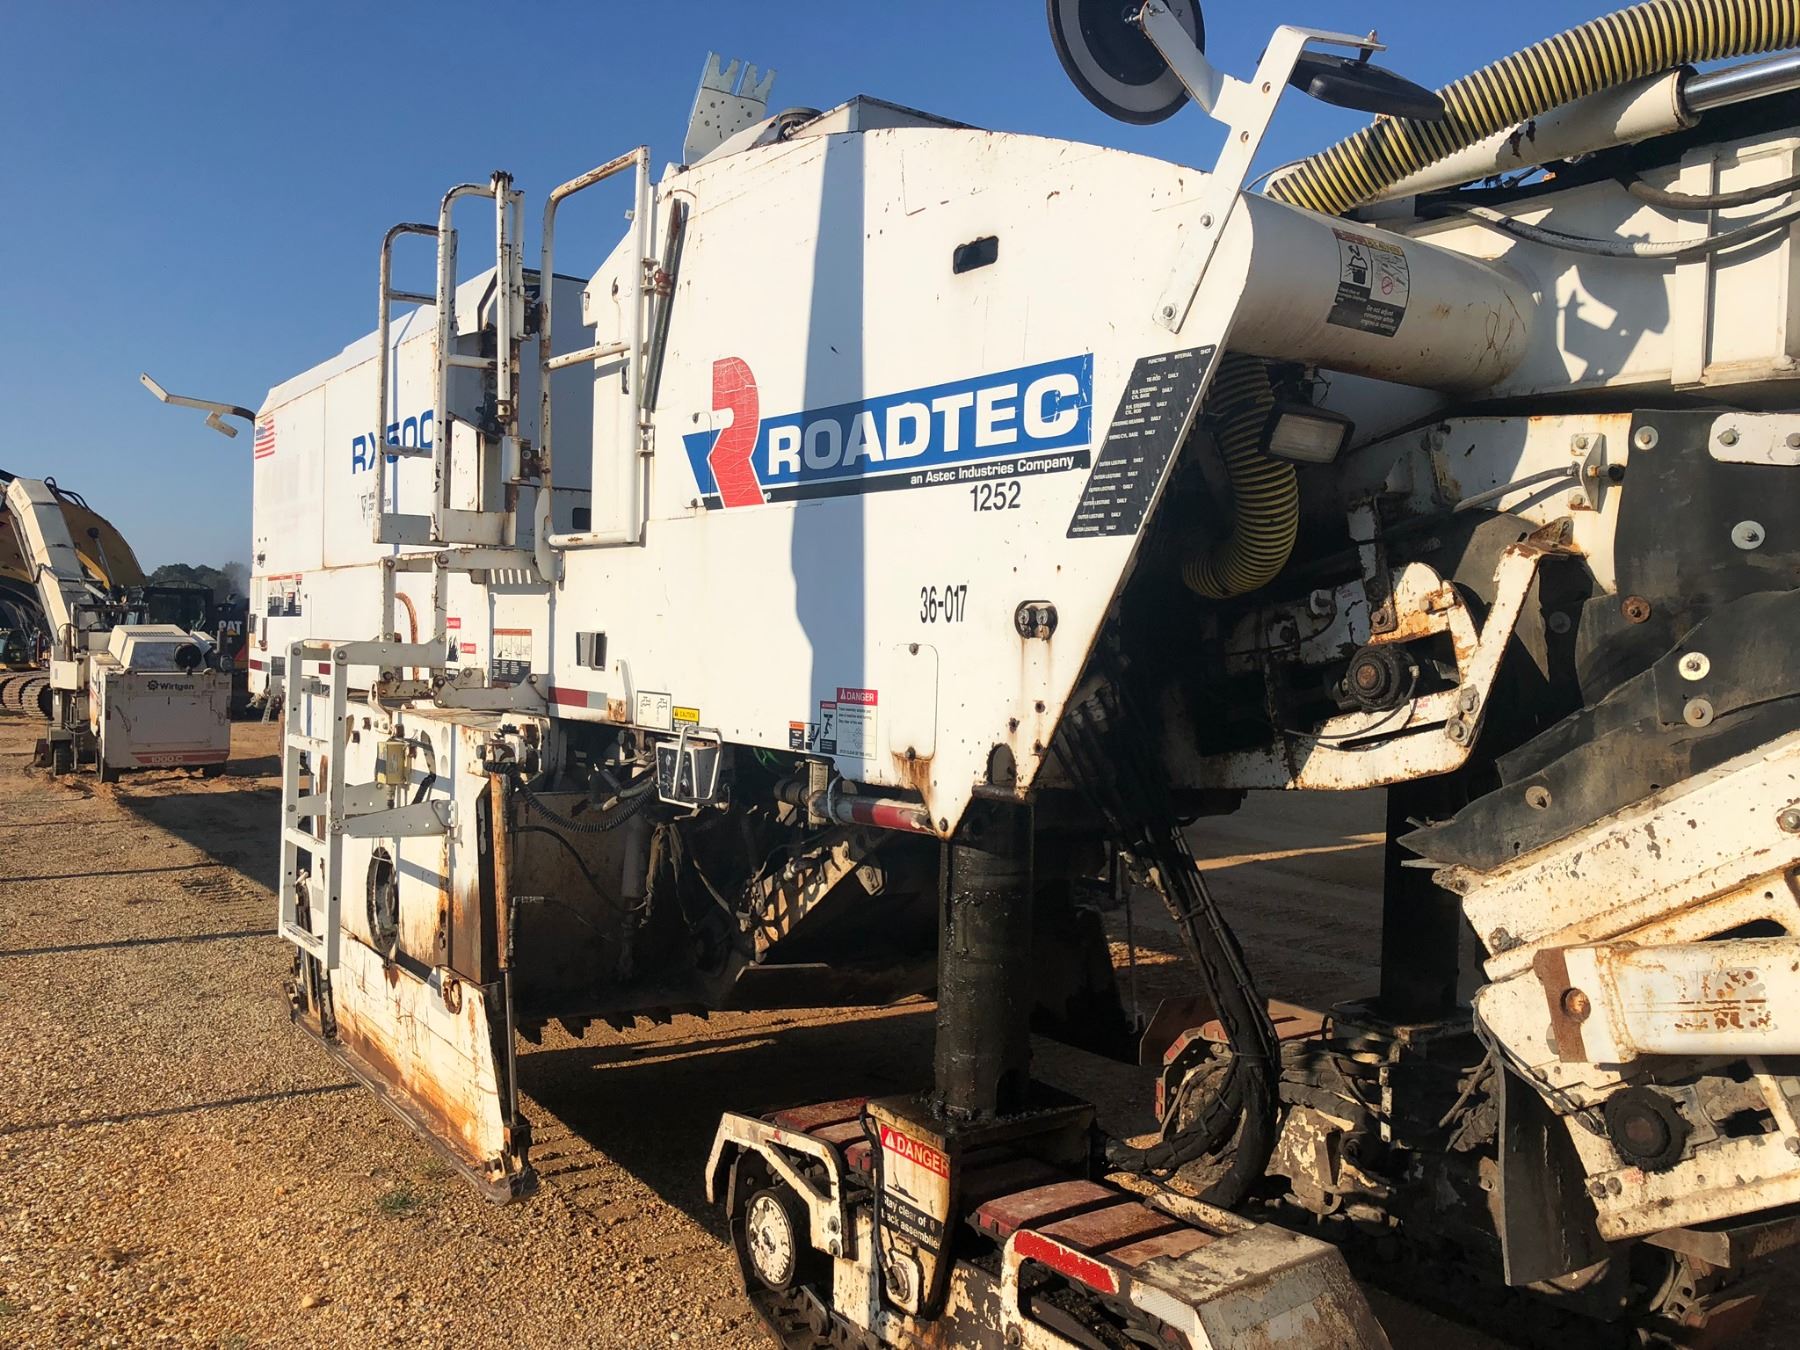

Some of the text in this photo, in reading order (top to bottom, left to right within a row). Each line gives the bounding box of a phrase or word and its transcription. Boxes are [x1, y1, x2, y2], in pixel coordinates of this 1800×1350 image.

[767, 373, 1080, 477] ROADTEC
[910, 456, 1074, 485] an Astec Industries Company
[970, 480, 1021, 512] 1252
[920, 584, 968, 624] 36-017
[160, 682, 195, 692] Wirtgen
[846, 690, 875, 703] DANGER
[896, 1135, 950, 1174] DANGER
[881, 1207, 899, 1226] tack
[884, 1194, 927, 1226] tay clear of
